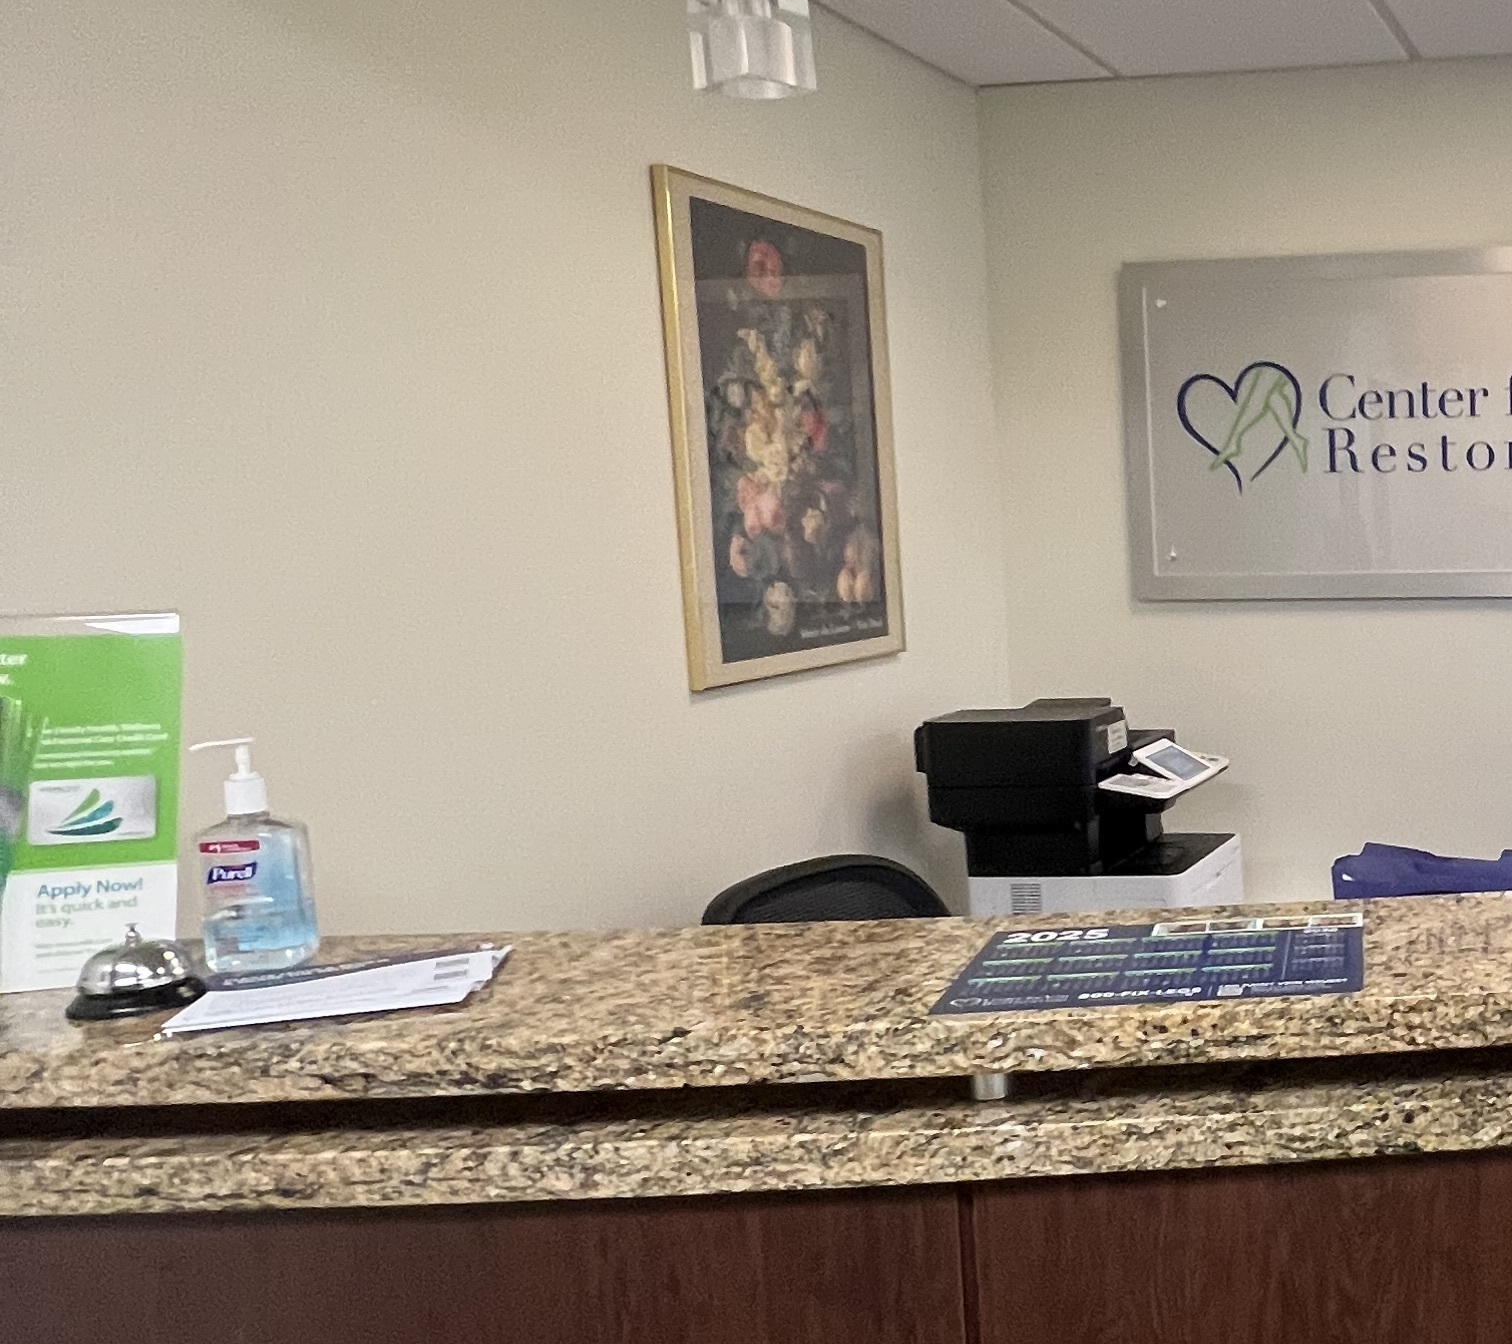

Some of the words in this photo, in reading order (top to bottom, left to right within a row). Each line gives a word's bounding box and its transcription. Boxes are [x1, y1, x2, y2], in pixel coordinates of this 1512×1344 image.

[1319, 373, 1489, 422] Center
[37, 882, 92, 900] Apply
[97, 878, 144, 892] Now!
[35, 903, 57, 915] It's
[61, 898, 105, 914] quick
[107, 896, 138, 910] and
[35, 917, 75, 929] easy.
[1003, 928, 1110, 944] 2025
